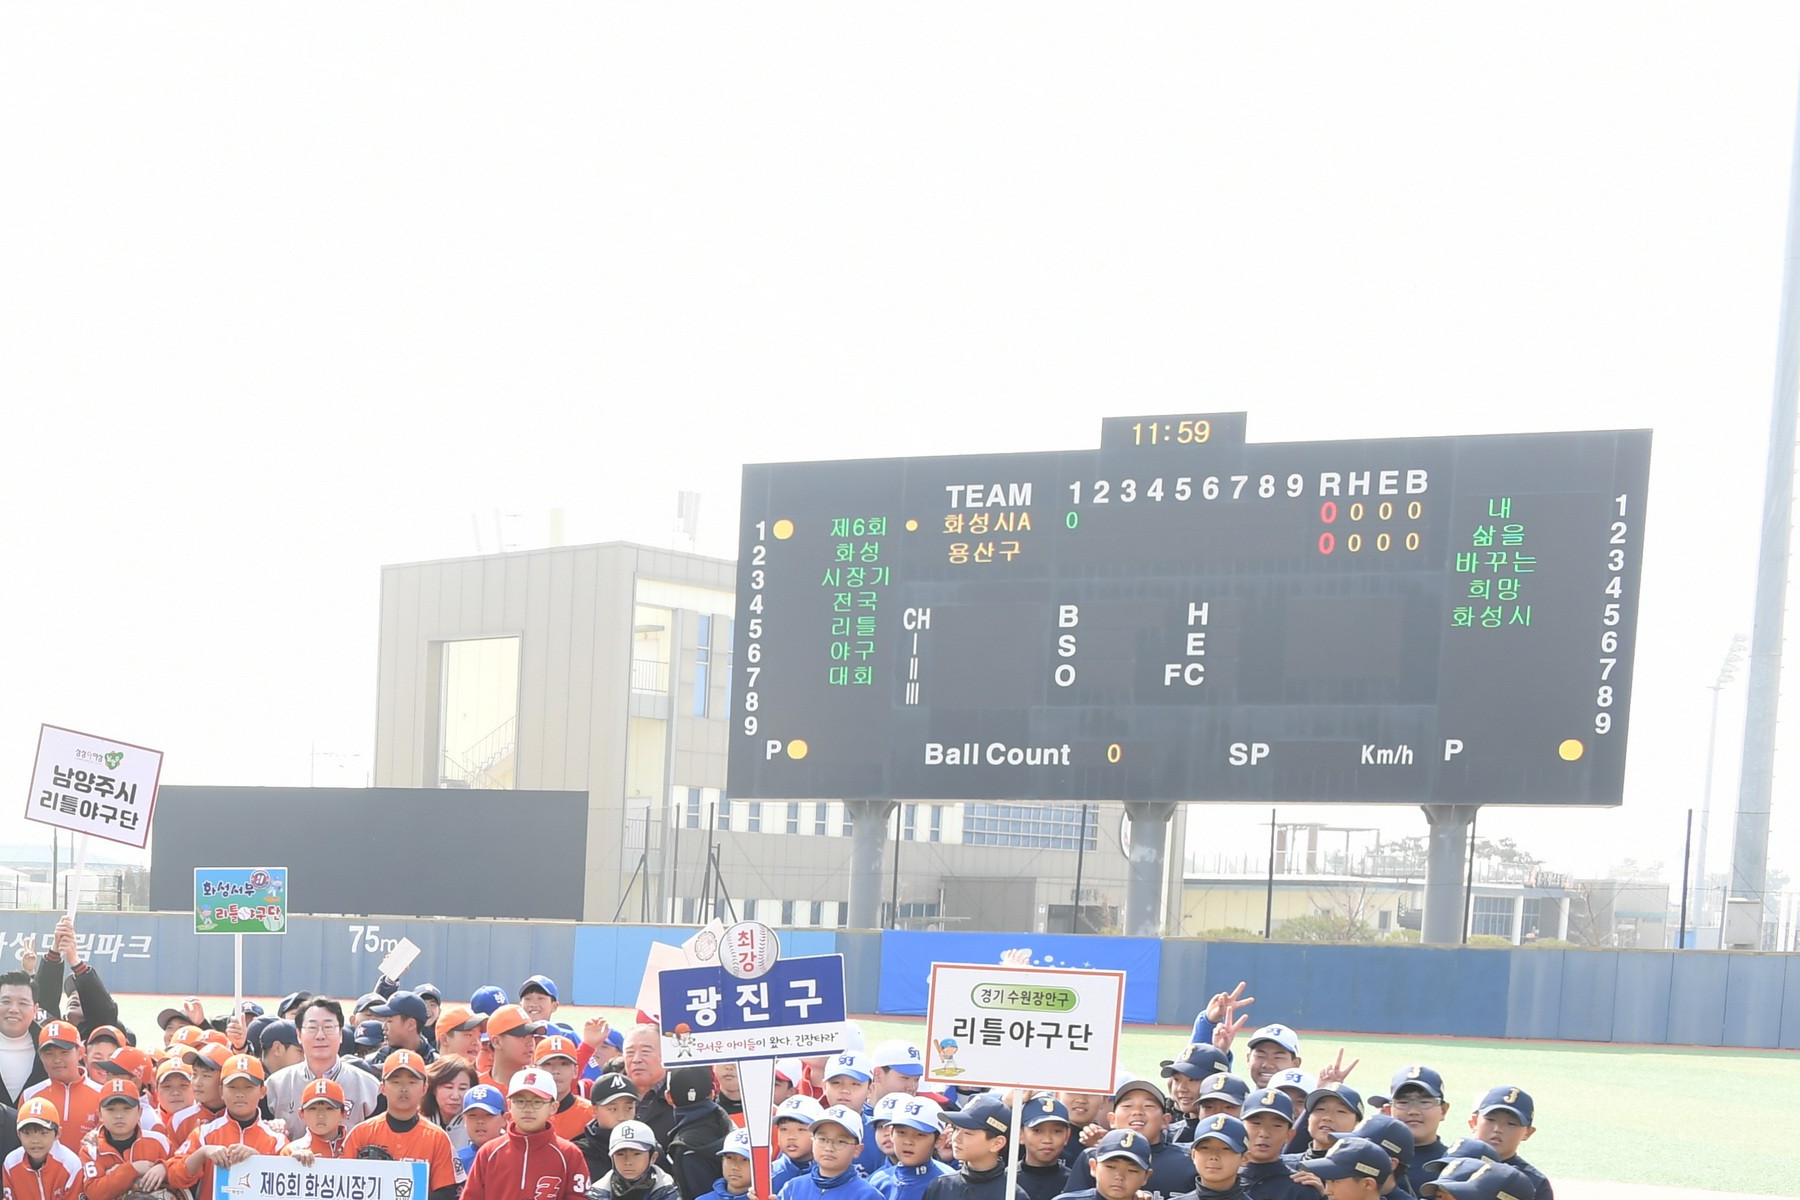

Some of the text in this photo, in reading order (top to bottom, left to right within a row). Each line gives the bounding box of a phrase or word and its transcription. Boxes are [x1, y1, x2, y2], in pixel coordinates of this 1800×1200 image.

[1132, 420, 1210, 446] 11:59
[945, 482, 1032, 509] TEAM
[1069, 480, 1081, 505] 1
[1092, 480, 1110, 504] 2
[1120, 478, 1137, 503] 3
[1146, 477, 1165, 502] 4
[1174, 477, 1192, 501] 5
[1202, 476, 1219, 500] 6
[1230, 475, 1249, 500] 7
[1258, 474, 1275, 499] 8
[1286, 473, 1304, 498] 9
[1488, 497, 1511, 519] 내
[1615, 493, 1628, 517] 1
[755, 520, 766, 541] 1
[830, 516, 887, 538] 제6회
[942, 511, 1031, 535] 화성시A
[1065, 511, 1079, 529] 0
[1609, 521, 1627, 544] 2
[1472, 524, 1525, 547] 삶을
[751, 545, 766, 566] 2
[835, 541, 879, 563] 화성
[948, 540, 1020, 564] 용산구
[1456, 551, 1537, 574] 바꾸는
[1607, 548, 1625, 572] 3
[750, 569, 765, 590] 3
[821, 566, 889, 588] 시장기
[1605, 576, 1623, 599] 4
[1467, 578, 1522, 601] 희망
[749, 594, 764, 615] 4
[833, 591, 878, 612] 전국
[903, 607, 931, 631] CH
[1058, 604, 1079, 628] B
[1187, 602, 1209, 626] H
[1451, 605, 1531, 628] 화성시
[1603, 603, 1620, 626] 5
[748, 618, 763, 639] 5
[831, 616, 876, 637] 리틀
[830, 641, 875, 661] 야구
[1057, 634, 1076, 658] S
[1186, 632, 1206, 656] E
[1601, 630, 1618, 653] 6
[747, 643, 761, 664] 6
[746, 667, 761, 688] 7
[829, 666, 872, 686] 대회
[1164, 662, 1205, 686] FC
[1599, 658, 1617, 681] 7
[745, 691, 759, 712] 8
[1596, 685, 1613, 708] 8
[744, 715, 758, 736] 9
[1595, 712, 1612, 735] 9
[766, 739, 782, 760] P
[924, 742, 980, 765] Ball
[985, 742, 1071, 766] Count
[1228, 742, 1270, 766] SP
[1361, 744, 1414, 765] Km/h
[1444, 739, 1464, 761] P
[53, 765, 137, 805] 남양주시
[39, 789, 139, 831] 리틀야구단
[203, 881, 255, 897] 화성서부
[685, 979, 823, 1027] 광진구
[981, 988, 1070, 1008] 경기 수원장안구
[953, 1017, 1093, 1051] 리틀야구단
[915, 1166, 927, 1175] 19
[260, 1171, 382, 1200] 제6회 화성시장기
